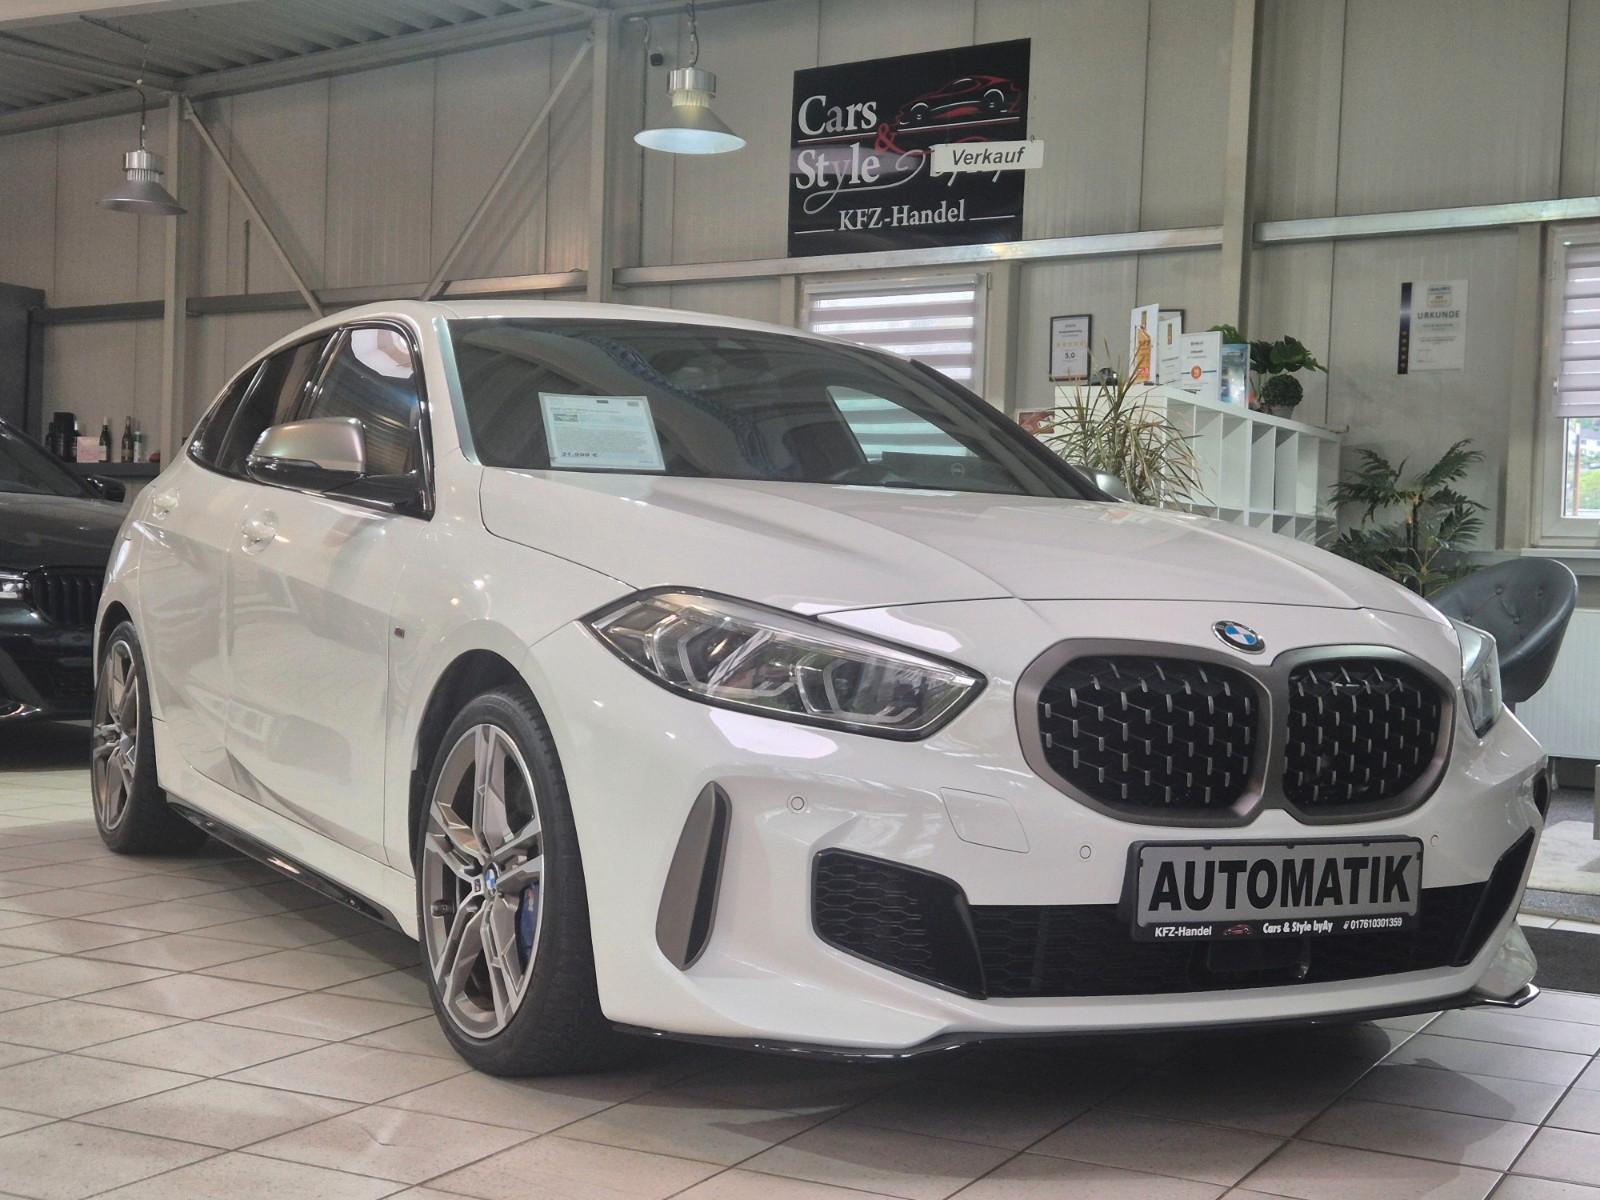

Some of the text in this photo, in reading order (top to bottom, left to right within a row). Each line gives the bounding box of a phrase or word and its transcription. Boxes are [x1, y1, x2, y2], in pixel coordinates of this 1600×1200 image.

[798, 95, 877, 136] Cars
[874, 122, 900, 154] &
[952, 146, 1026, 166] Verkauf
[795, 142, 882, 208] Style
[838, 199, 966, 232] KFZ-Handel
[1417, 310, 1460, 320] URKUNDE
[1148, 855, 1412, 911] AUTOMATIK
[1154, 925, 1212, 938] KFZ-Handel
[1262, 922, 1281, 934] Cars
[1283, 921, 1290, 933] &
[1291, 920, 1312, 935] Style
